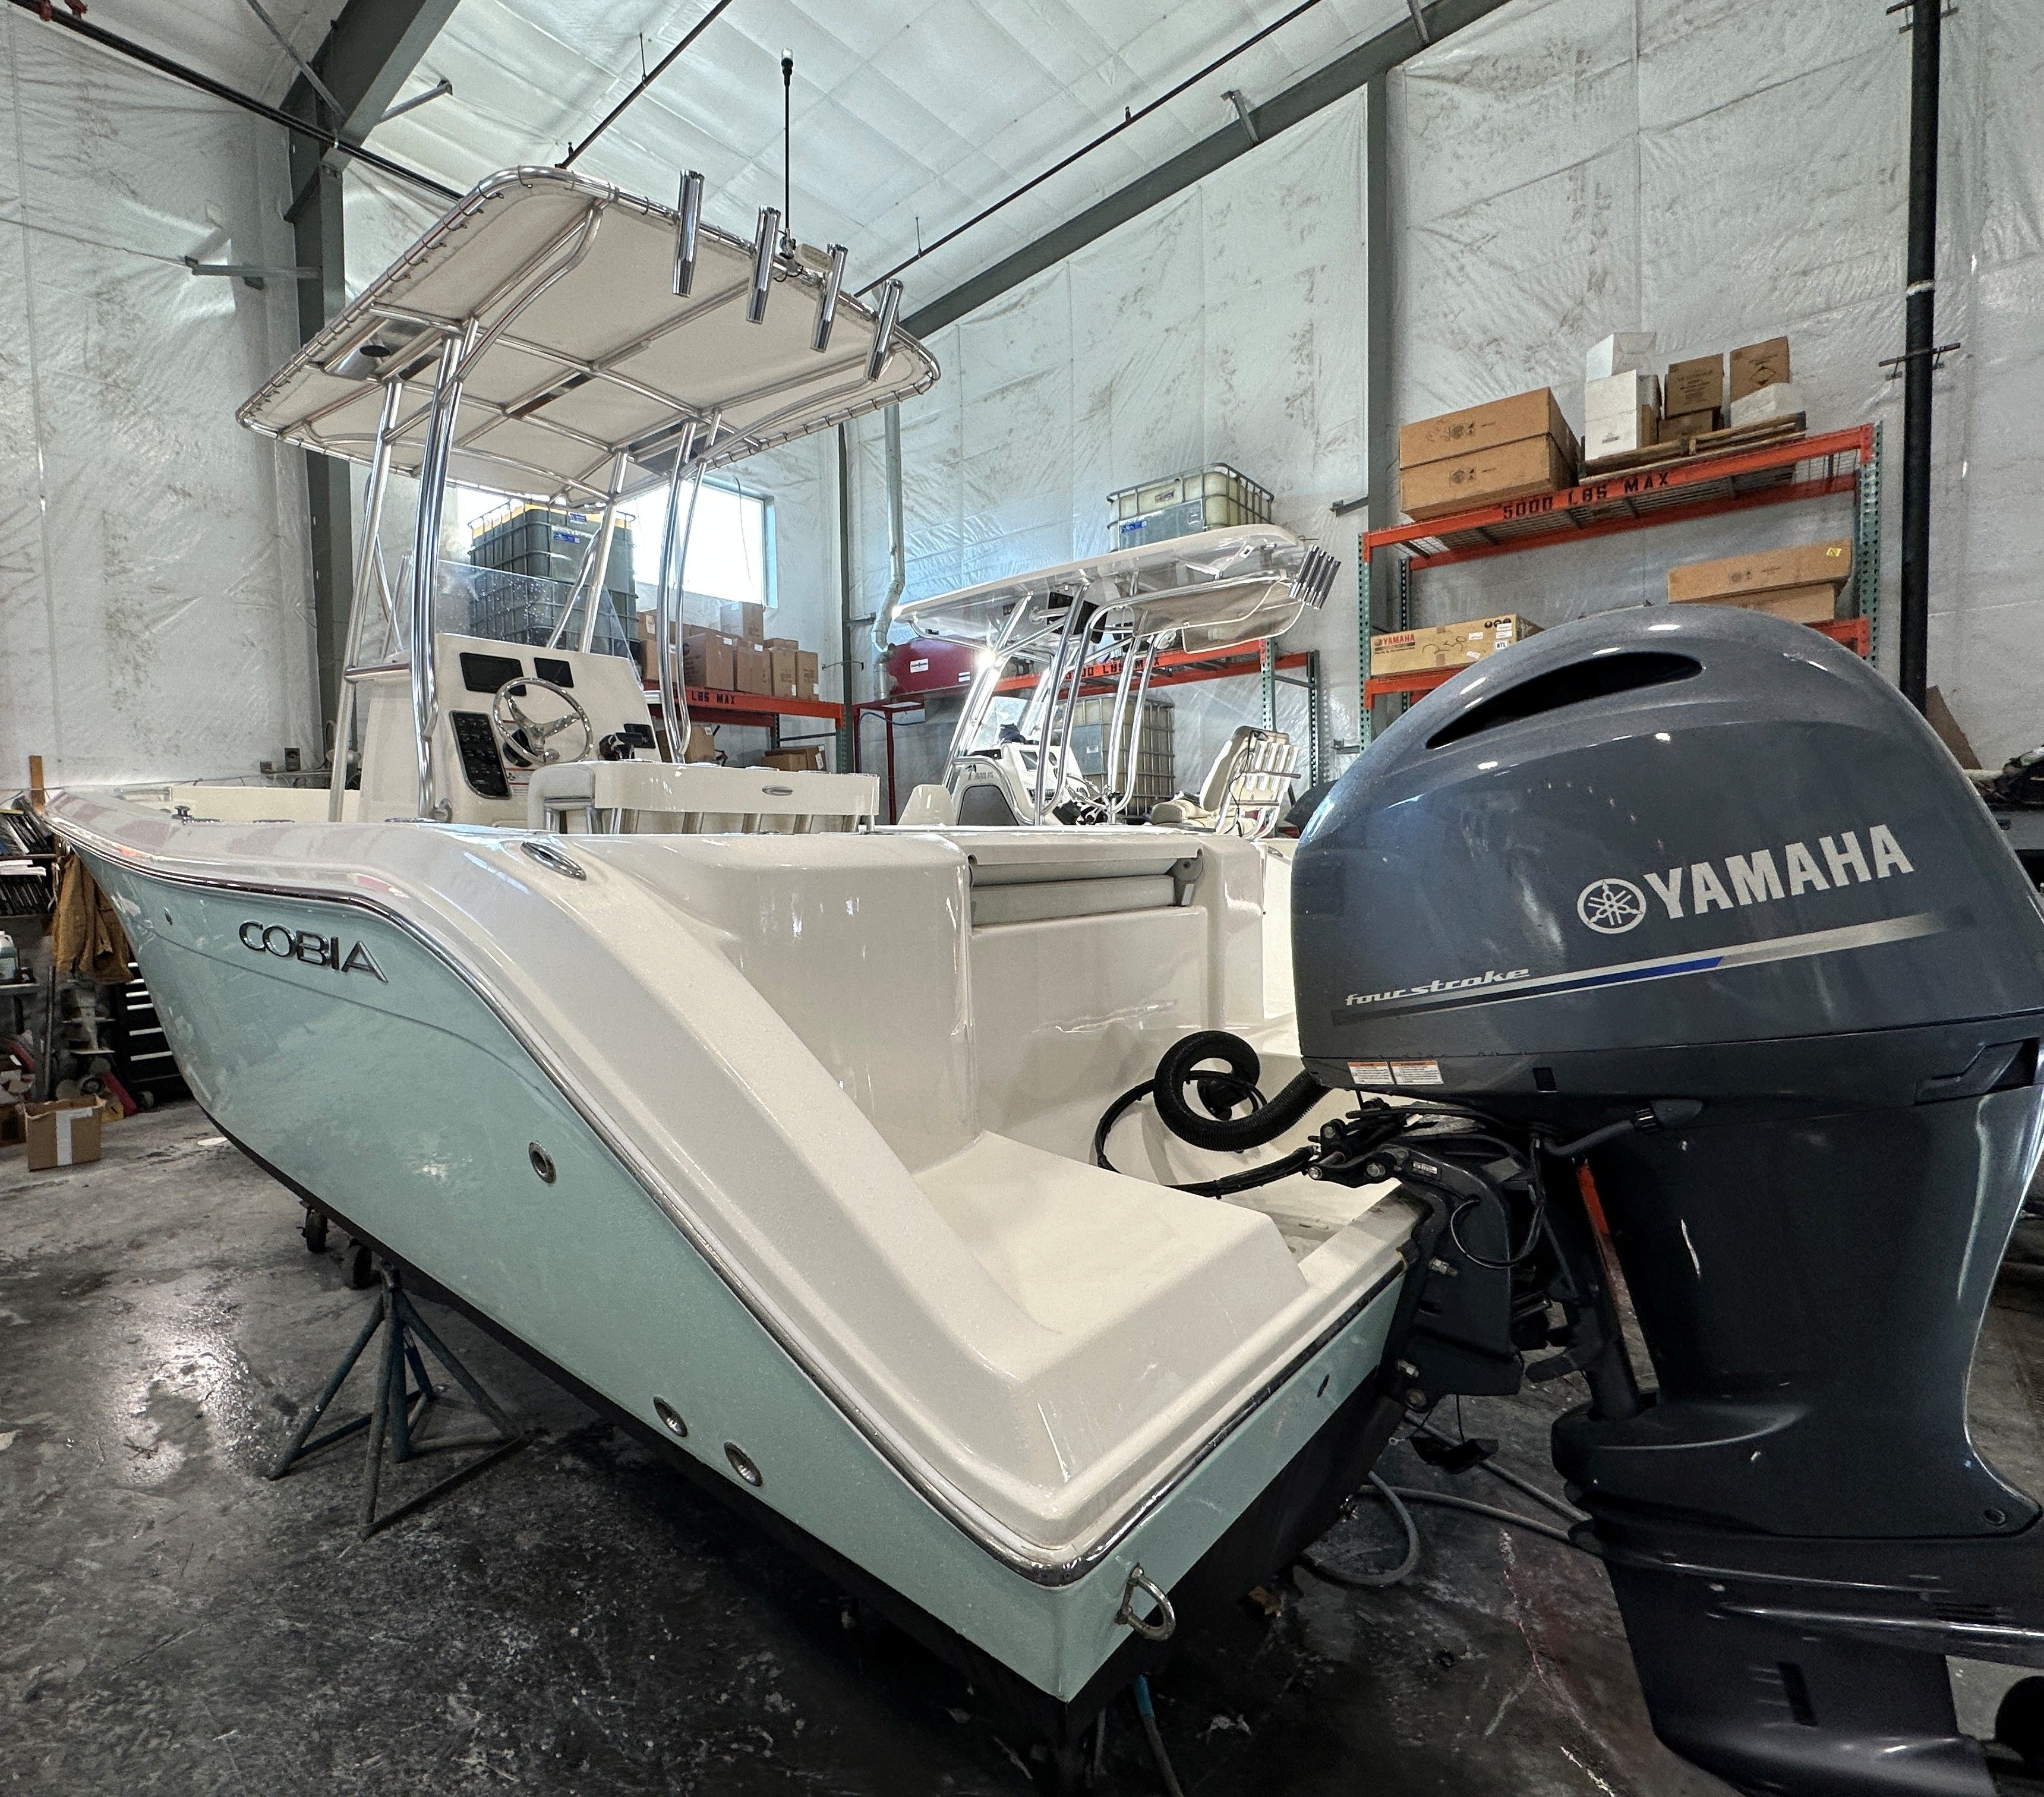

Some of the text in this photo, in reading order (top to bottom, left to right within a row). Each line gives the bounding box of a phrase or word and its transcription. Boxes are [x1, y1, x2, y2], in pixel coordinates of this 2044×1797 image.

[1503, 471, 1668, 519] 5000 LBS MAX
[1383, 633, 1415, 645] YAMAHA
[692, 691, 709, 702] LBS
[717, 693, 736, 705] MAX
[1643, 824, 1914, 920] YAMAHA
[239, 920, 389, 983] COBIA
[1345, 968, 1531, 1006] four stroke
